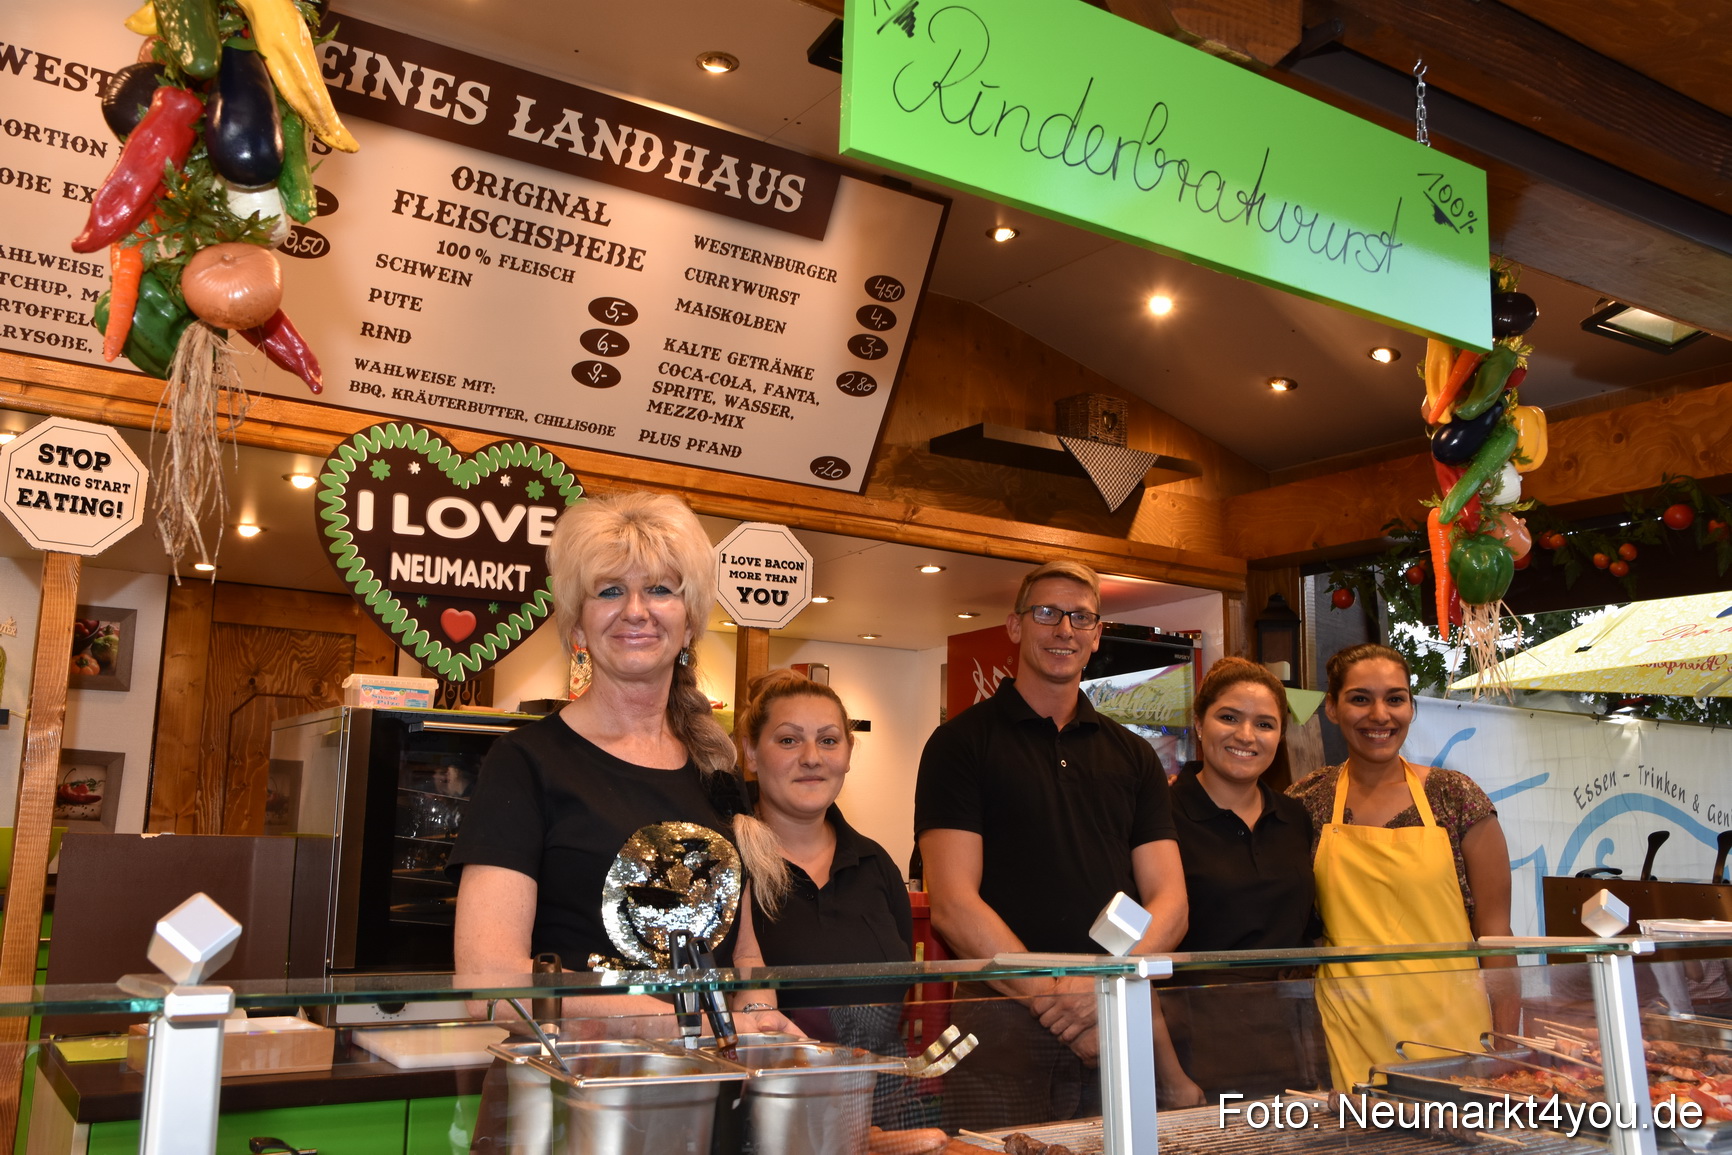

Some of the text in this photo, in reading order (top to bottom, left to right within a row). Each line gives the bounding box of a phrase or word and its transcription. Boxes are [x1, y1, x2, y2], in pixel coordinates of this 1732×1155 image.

[0, 118, 108, 158] ORTION
[507, 94, 806, 213] LANDHAUS
[893, 6, 1402, 273] Rinderbratwurst
[450, 166, 612, 228] ORIGINAL
[1417, 173, 1478, 234] 100%
[392, 189, 647, 272] FLEISCHSPIEßE
[375, 253, 473, 288] SCHWEIN
[498, 253, 576, 285] FLEISCH
[693, 234, 838, 284] WESTERNBURGER
[368, 287, 423, 312] PUTE
[684, 267, 800, 306] CURRYWURST
[874, 278, 902, 301] 4,50
[360, 321, 412, 344] RIND
[674, 298, 787, 335] MAISKOLBEN
[0, 324, 92, 354] RYSOßE,
[353, 357, 496, 395] WAHLWEISE MIT:
[663, 337, 815, 381] KALTE GETRÄNKE
[349, 380, 386, 399] BBQ,
[391, 386, 528, 423] KRÄUTERBUTTER,
[652, 380, 795, 421] SPRITE, WASSER,
[658, 361, 820, 407] COCA-COLA, FANTA,
[840, 374, 876, 392] 2,80
[646, 399, 746, 430] MEZZO-MIX
[38, 443, 111, 473] STOP
[638, 428, 743, 459] PLUS PFAND
[15, 467, 131, 494] TALKING START
[16, 487, 124, 520] EATING!
[356, 489, 557, 546] I LOVE
[390, 551, 531, 592] NEUMARKT
[721, 553, 804, 571] I LOVE BACON
[729, 570, 797, 584] MORE THAN
[736, 586, 789, 606] YOU
[1573, 770, 1617, 810] Essen
[1638, 765, 1686, 804] Trinken
[1692, 794, 1700, 814] &
